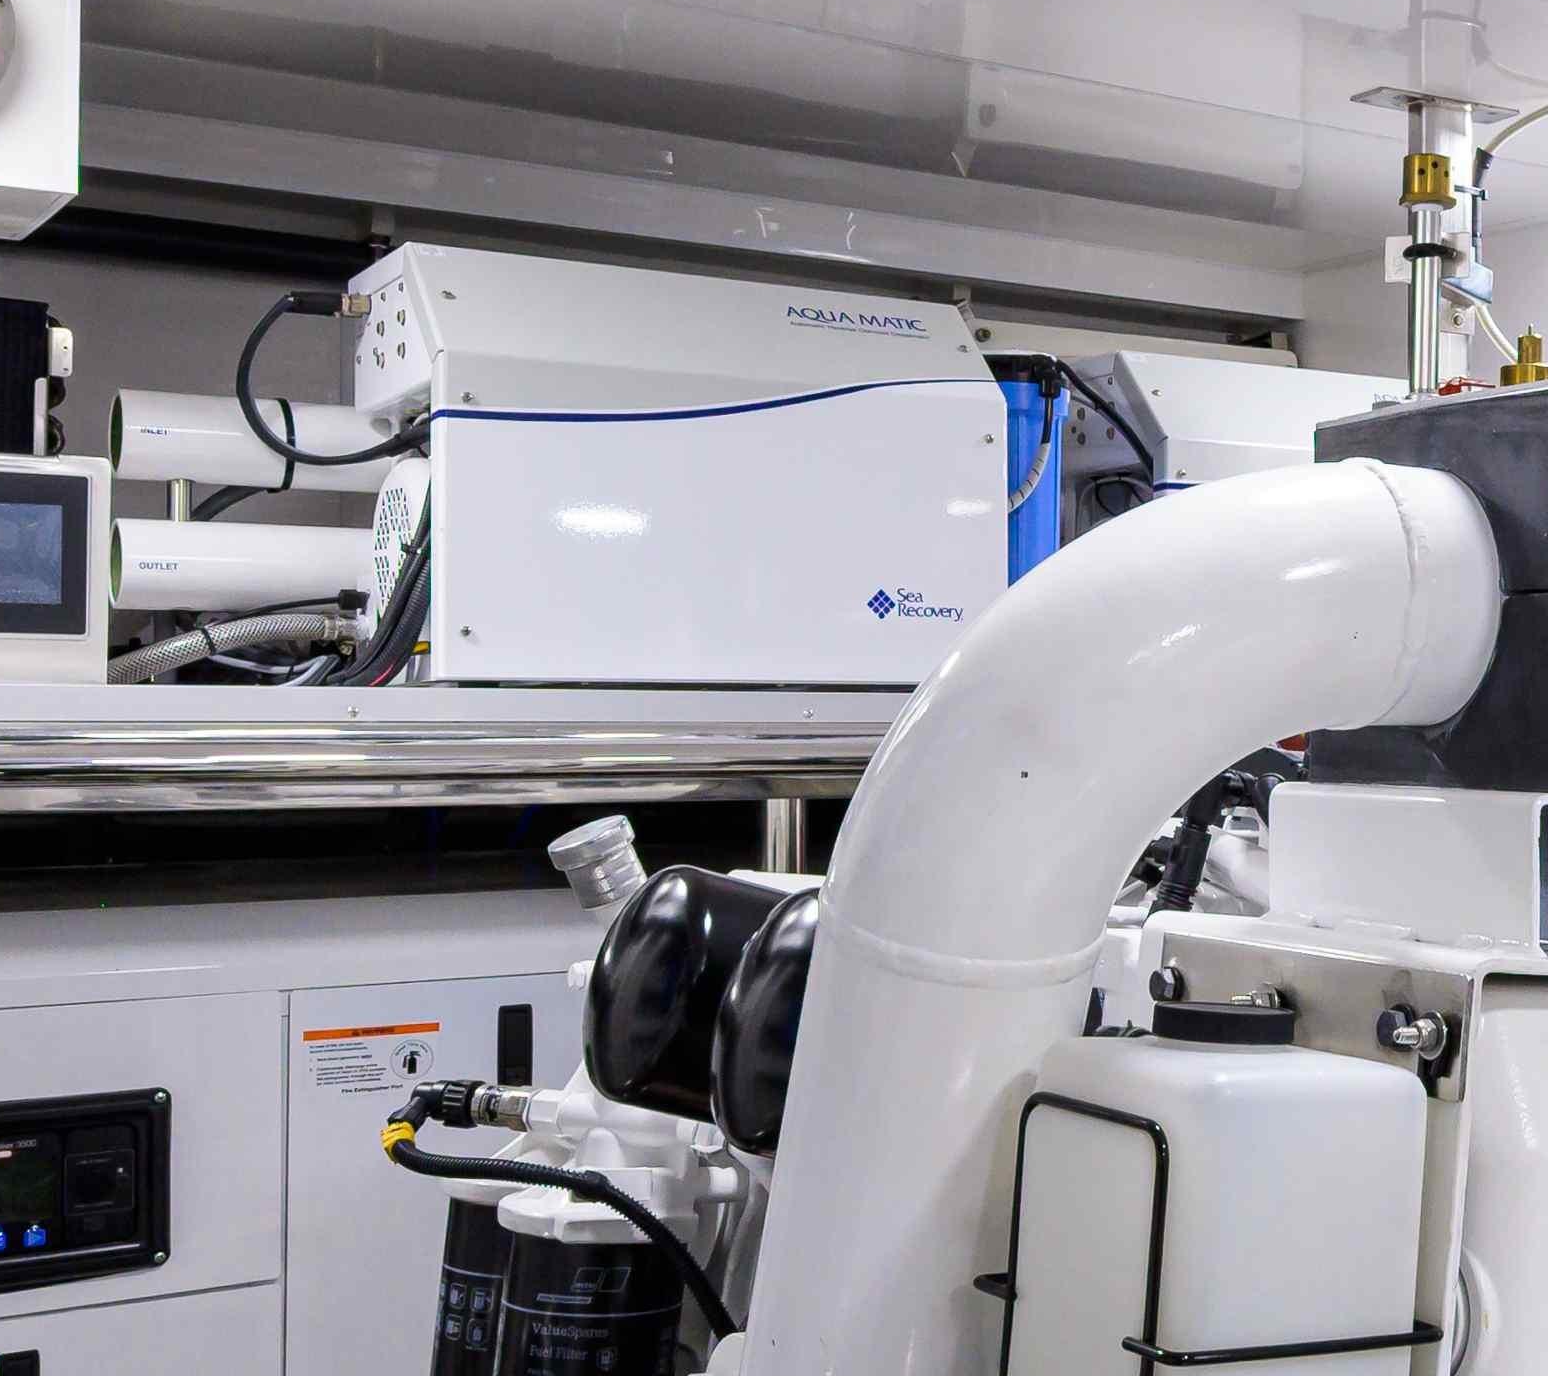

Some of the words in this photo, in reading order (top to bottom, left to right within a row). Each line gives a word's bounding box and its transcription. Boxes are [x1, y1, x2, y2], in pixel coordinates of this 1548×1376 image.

[787, 304, 855, 324] AQUA
[859, 312, 927, 332] MATIC
[138, 561, 178, 570] OUTLET
[896, 587, 924, 603] Sea
[897, 602, 964, 622] Recovery
